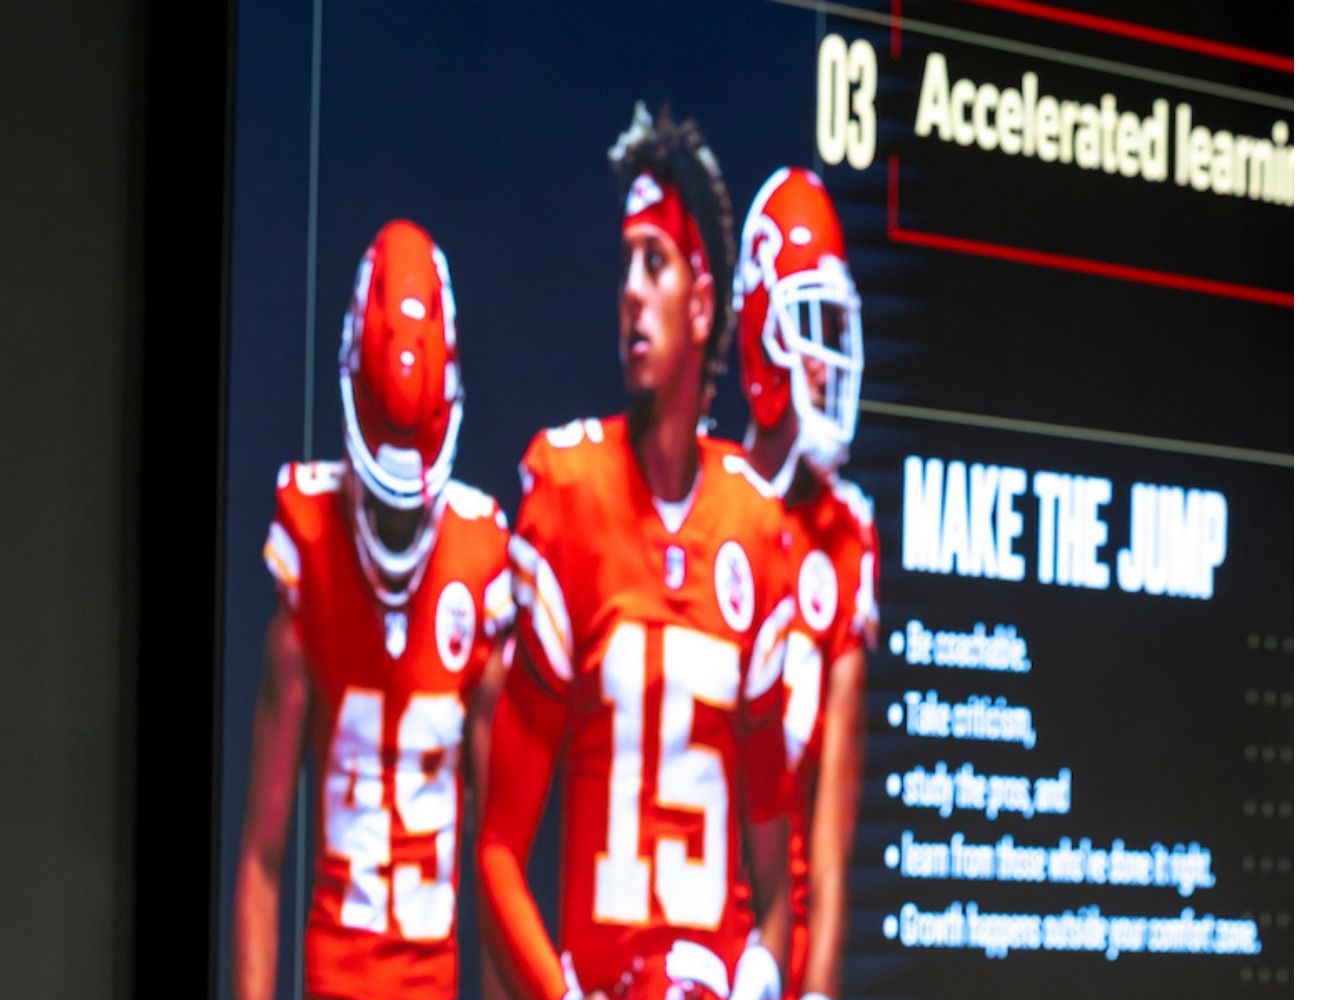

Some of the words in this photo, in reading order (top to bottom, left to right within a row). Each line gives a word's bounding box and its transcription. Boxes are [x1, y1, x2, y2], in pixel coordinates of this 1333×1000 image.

[817, 33, 877, 170] 03
[915, 53, 1168, 182] Accelerated
[903, 455, 1026, 582] MAKE
[1033, 470, 1112, 590] THE
[1117, 481, 1228, 600] JUMP
[904, 688, 952, 738] Take
[594, 621, 741, 931] 15
[955, 761, 987, 810] the
[1034, 766, 1071, 814] and
[901, 830, 949, 878] learn
[950, 833, 995, 880] from
[996, 834, 1047, 882] those
[1107, 838, 1153, 886] done
[900, 901, 966, 948] Growth
[1042, 904, 1107, 951] outside
[1107, 917, 1147, 961] your
[1147, 906, 1214, 953] comfort
